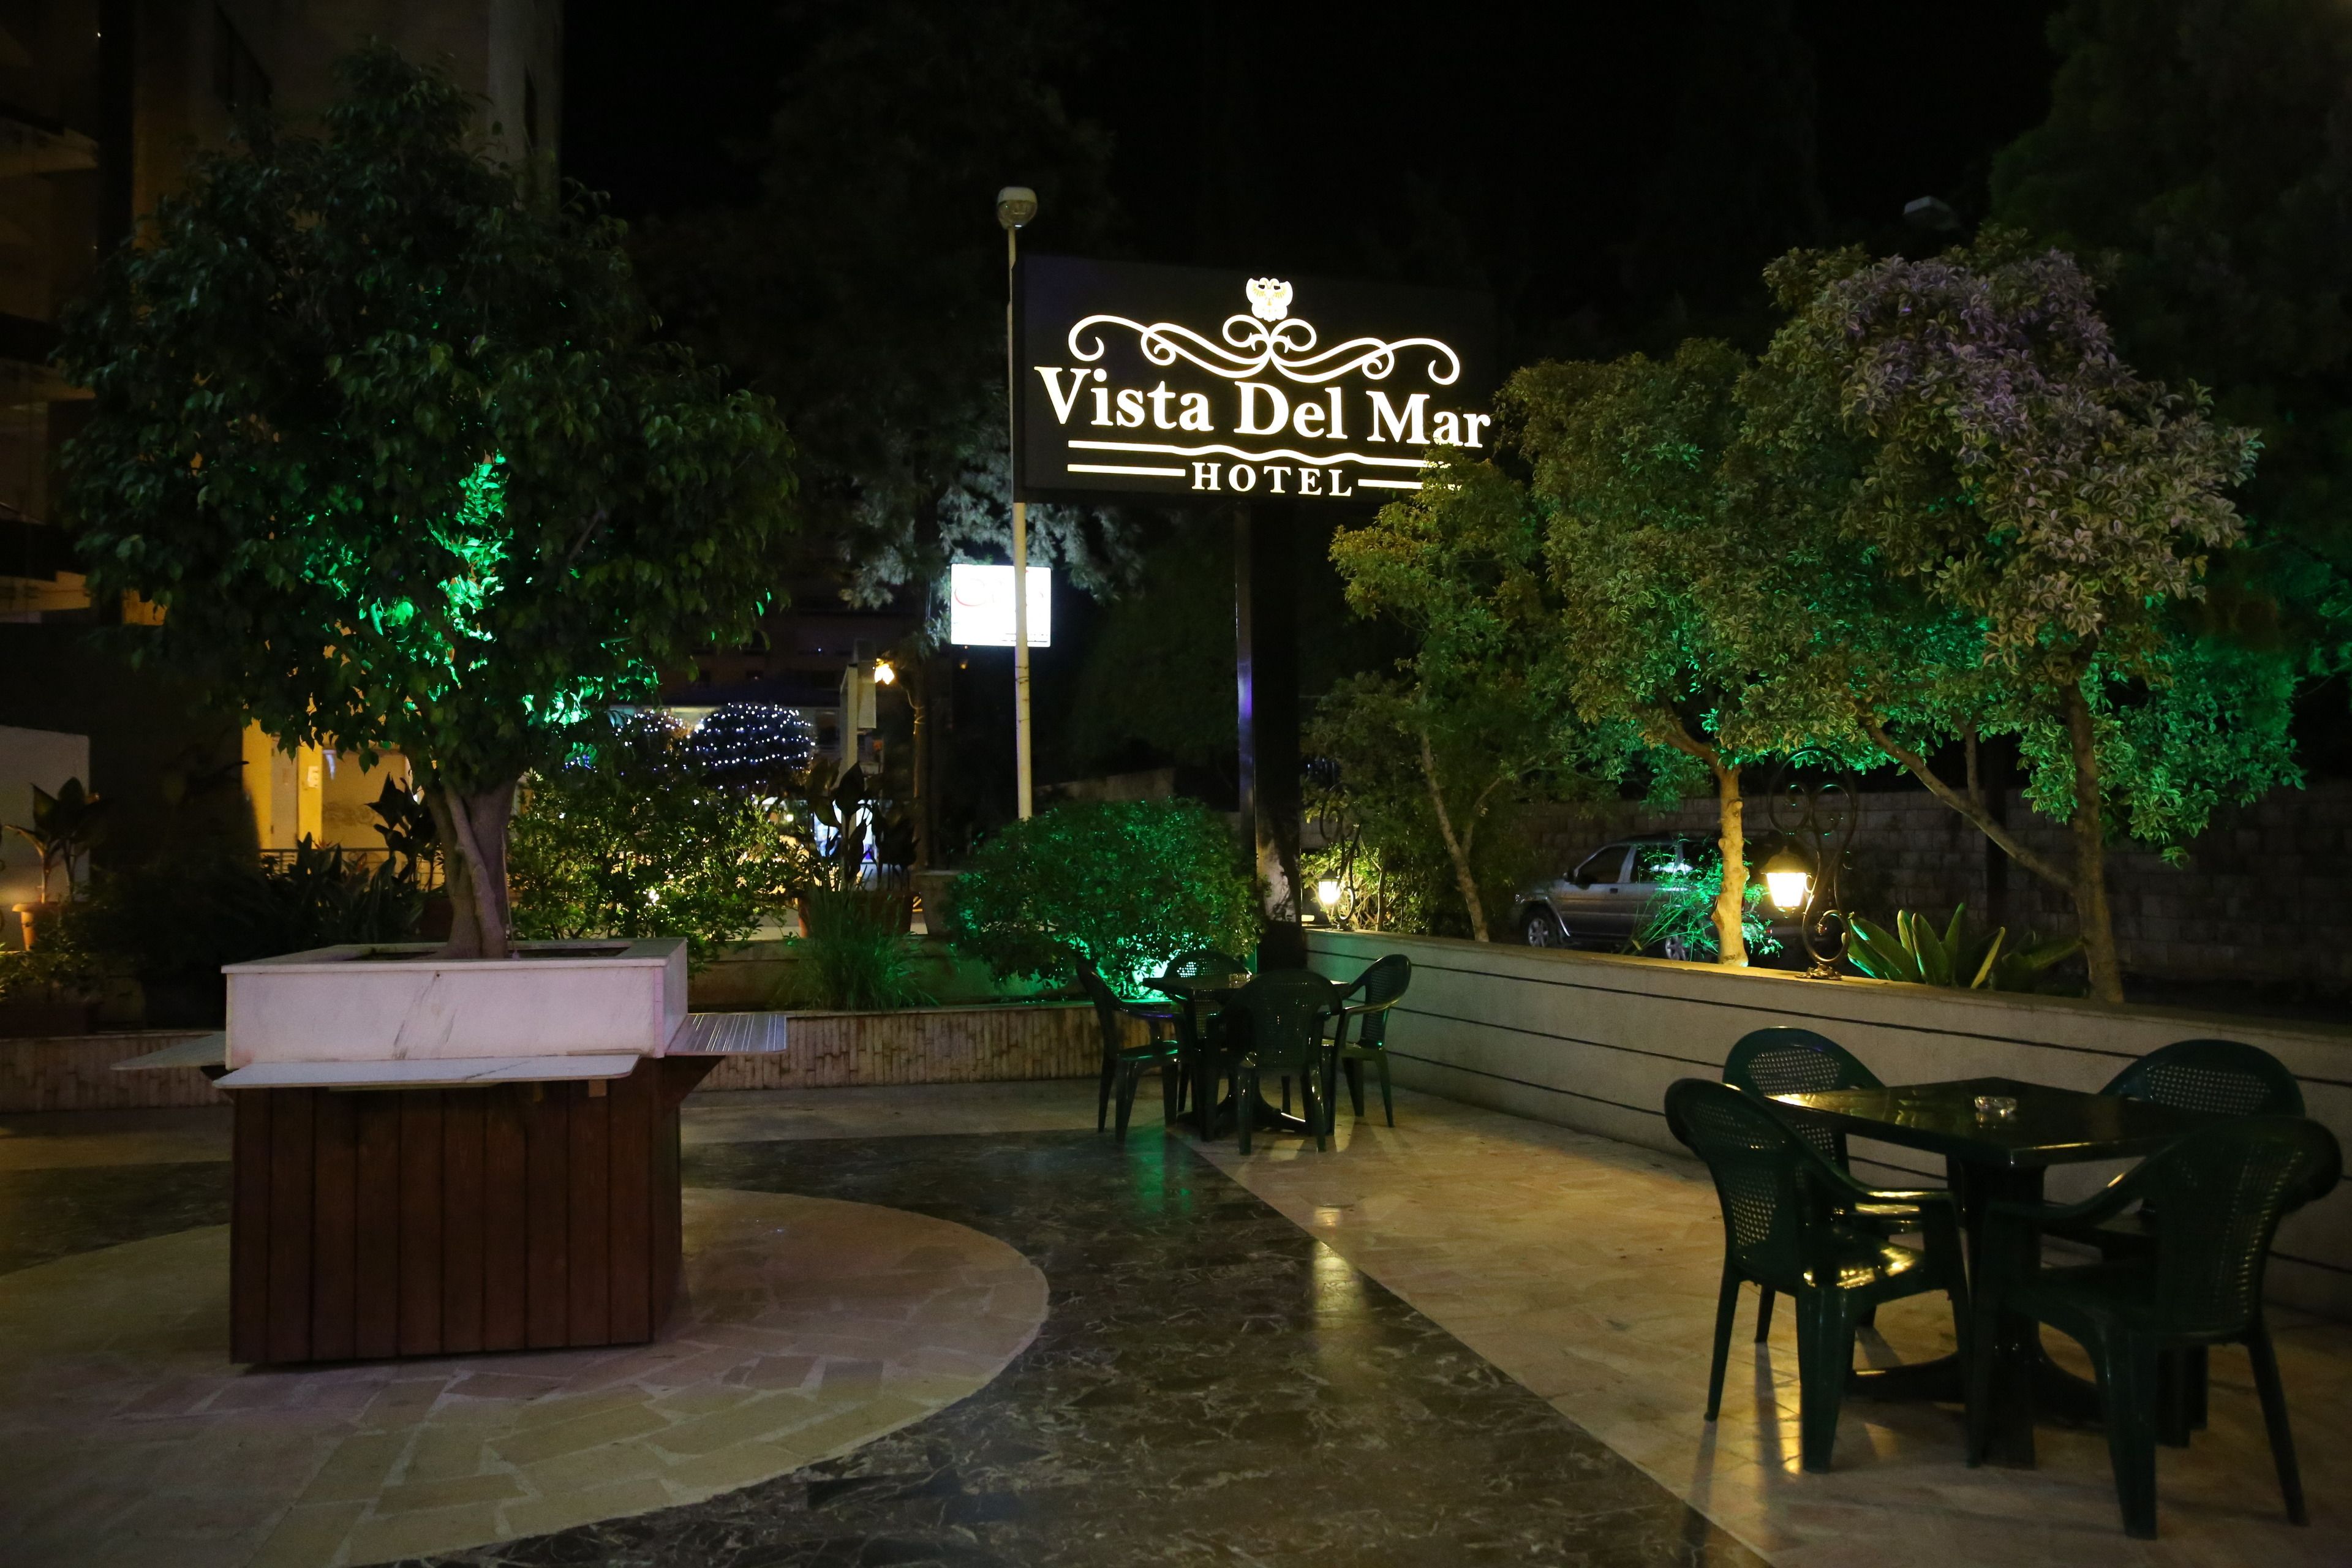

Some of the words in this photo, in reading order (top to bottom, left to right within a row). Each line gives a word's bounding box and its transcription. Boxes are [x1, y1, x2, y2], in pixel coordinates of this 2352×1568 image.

[1034, 366, 1214, 431] Vista
[1233, 380, 1349, 439] Del
[1365, 390, 1491, 448] Mar
[1191, 461, 1352, 497] HOTEL
